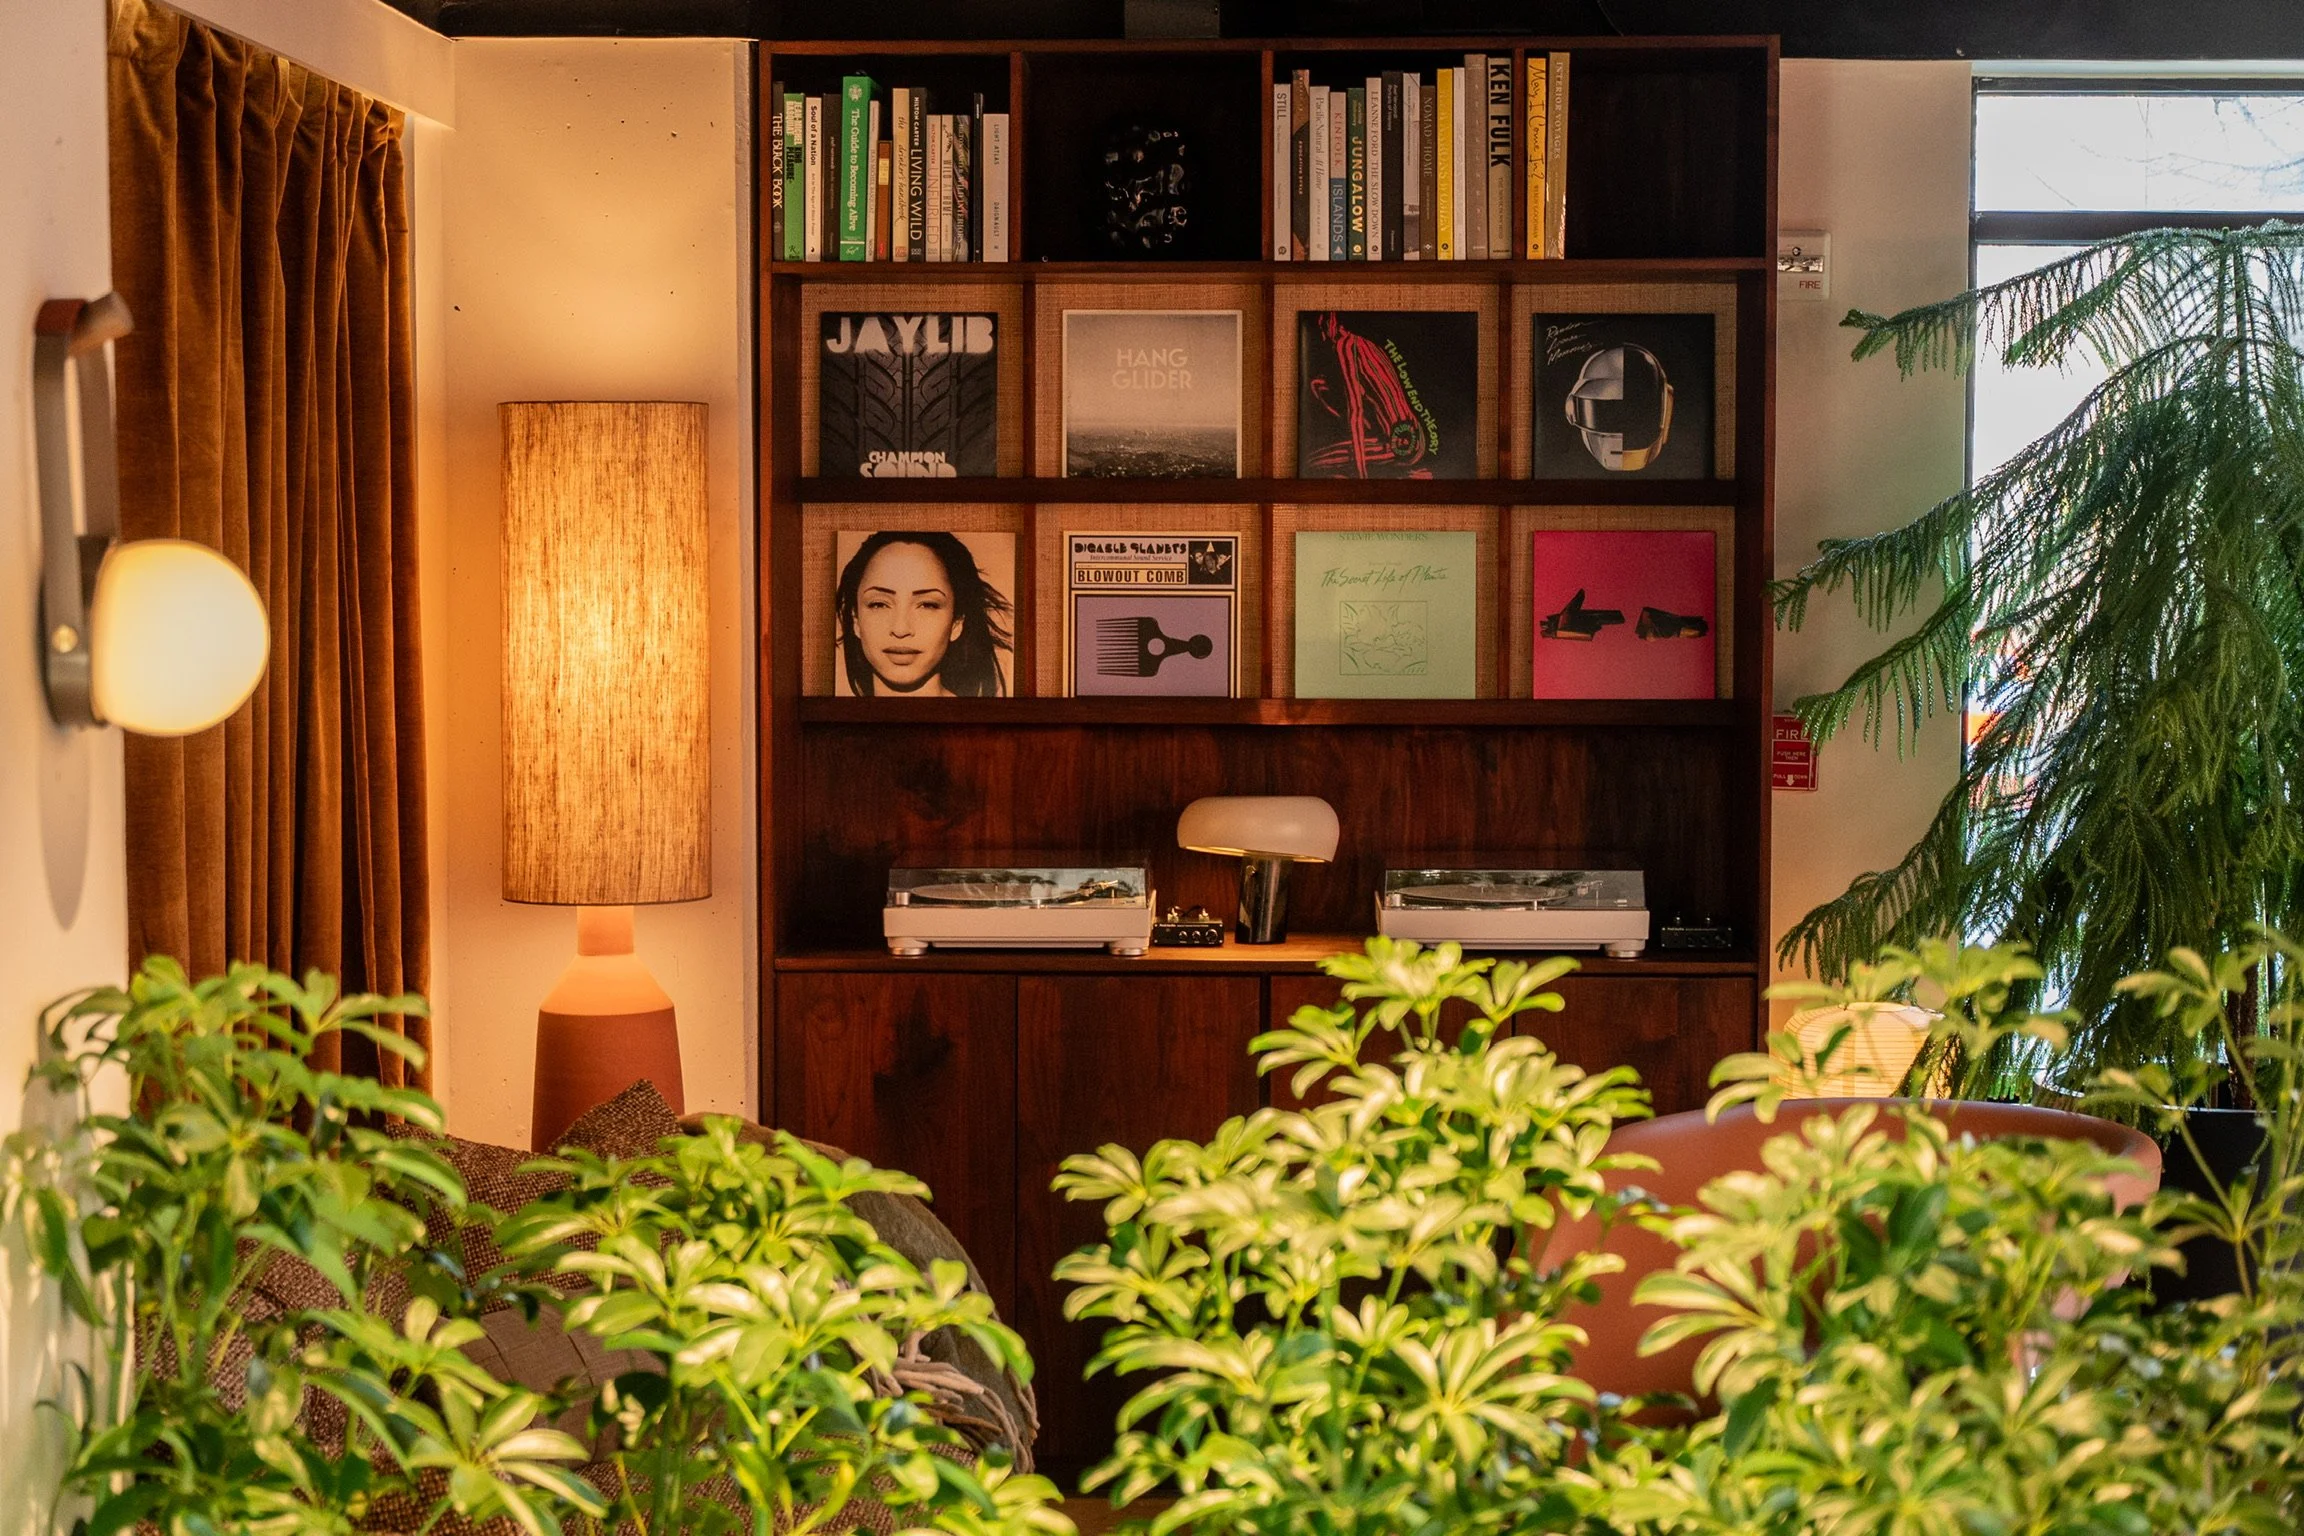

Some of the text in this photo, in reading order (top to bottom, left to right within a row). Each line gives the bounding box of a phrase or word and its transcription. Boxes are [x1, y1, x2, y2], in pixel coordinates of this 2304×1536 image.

[810, 105, 818, 123] Soul
[851, 108, 860, 127] The
[1276, 92, 1287, 120] STILL
[1315, 97, 1324, 123] Pacific
[1423, 97, 1433, 137] NOMAD
[1490, 64, 1510, 168] KEN FULK
[1553, 62, 1564, 159] INTERIOR VOYAGES
[810, 124, 818, 133] of
[1528, 65, 1546, 180] May I Come In?
[810, 140, 818, 166] Nation
[850, 127, 860, 153] Guide
[1315, 124, 1324, 154] Natural
[1333, 112, 1342, 167] KINFOLK
[772, 113, 783, 208] THE BLACK BOOK
[850, 154, 859, 164] to
[894, 116, 907, 226] the drinker's handbook
[910, 149, 922, 197] LIVING
[942, 159, 952, 179] WILD
[1370, 91, 1379, 238] LEANNE FORD THE SLOW DOWN
[1423, 146, 1433, 177] HOME
[847, 165, 859, 208] Becoming
[1315, 167, 1324, 190] Home
[1352, 136, 1363, 233] JUNGALOW
[848, 208, 858, 231] Alive
[910, 201, 922, 240] WILD
[927, 167, 940, 244] UNFURLED
[942, 195, 952, 216] HOME
[1332, 184, 1343, 242] ISLANDS
[956, 200, 964, 243] INTERIORS
[1799, 281, 1821, 289] FIRE
[826, 315, 994, 353] JAYLIB
[1116, 348, 1189, 368] HANG
[1112, 369, 1193, 390] GLIDER
[1384, 339, 1439, 456] THE LOW END THEORY
[868, 451, 946, 464] CHAMPION
[1077, 570, 1184, 583] BLOWOUT COMB
[1321, 568, 1340, 588] The
[1339, 568, 1378, 588] Secret
[1374, 566, 1396, 592] Life
[1398, 569, 1412, 593] of
